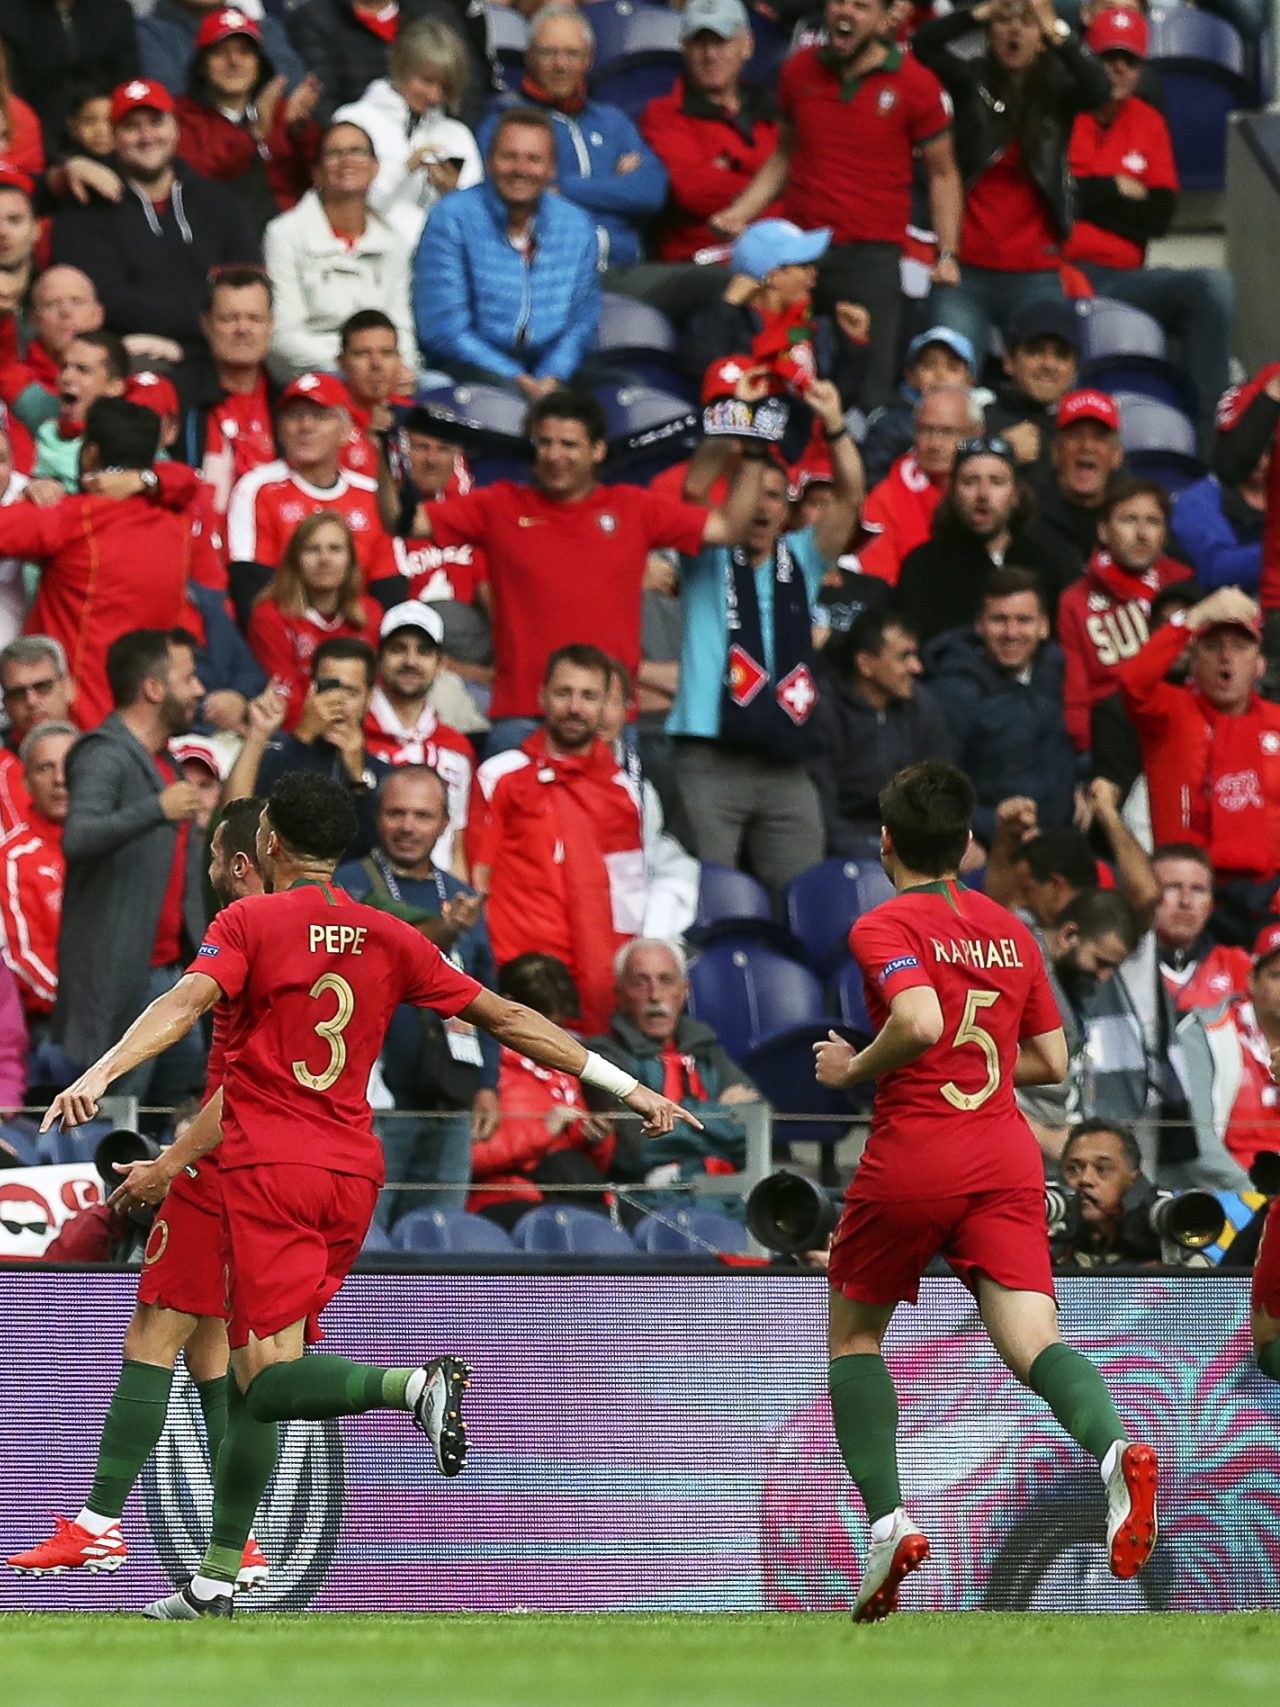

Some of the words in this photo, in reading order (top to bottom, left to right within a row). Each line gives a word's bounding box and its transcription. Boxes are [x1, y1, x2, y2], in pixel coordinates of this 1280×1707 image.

[308, 923, 368, 955] PEPE
[929, 936, 1025, 969] RAPHAEL
[291, 971, 356, 1092] 3
[939, 988, 1002, 1111] 5
